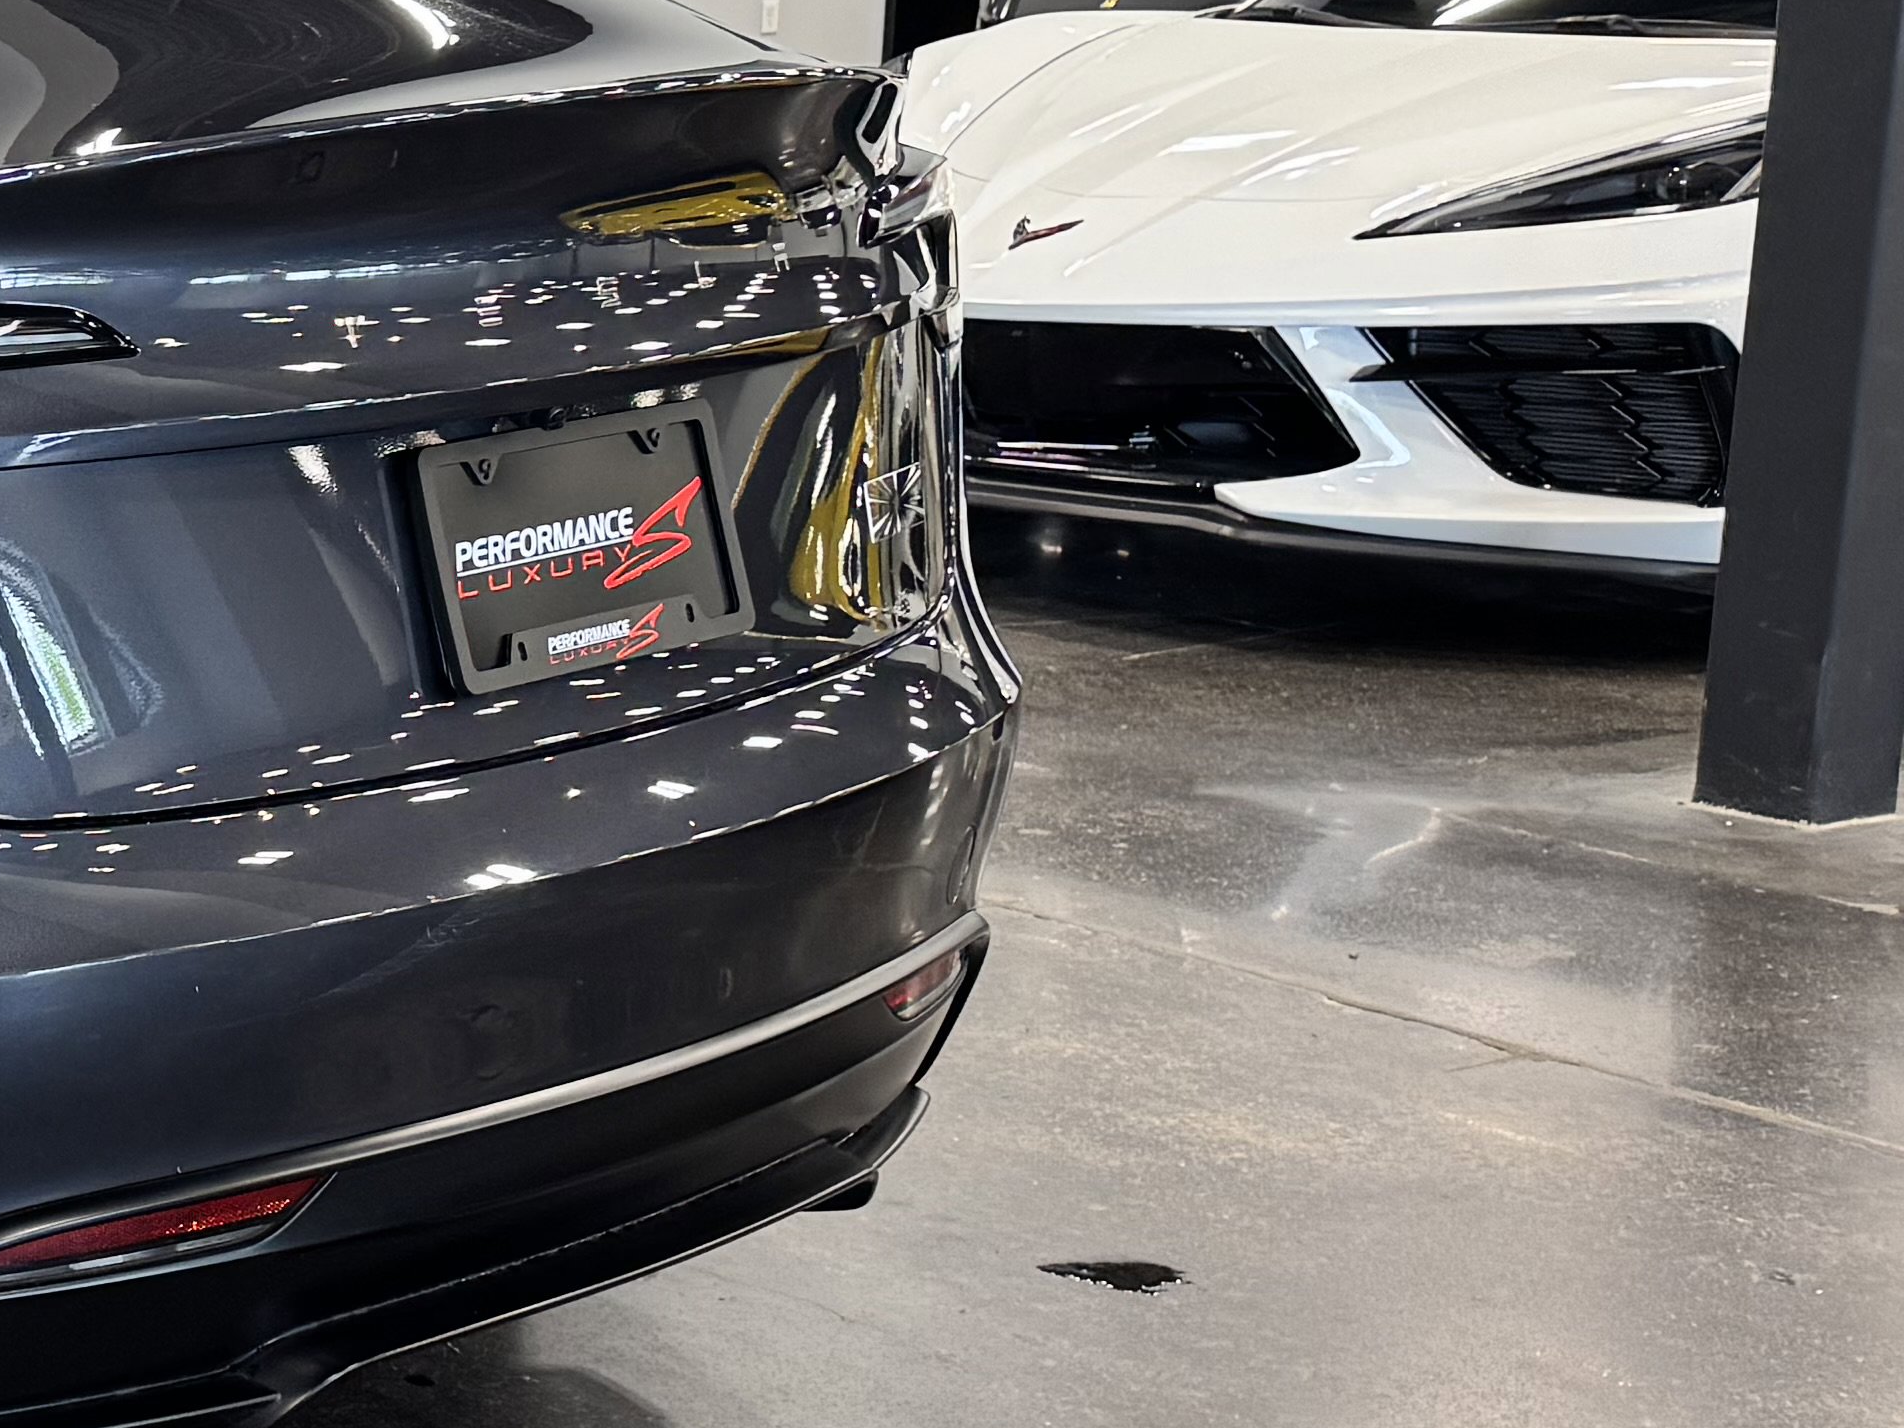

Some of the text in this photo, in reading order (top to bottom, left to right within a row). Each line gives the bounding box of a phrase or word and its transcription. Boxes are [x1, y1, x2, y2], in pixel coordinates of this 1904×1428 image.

[455, 506, 634, 572] PERFORMANCE
[457, 543, 632, 599] LUXURY
[547, 618, 631, 653] PERFORMANCE
